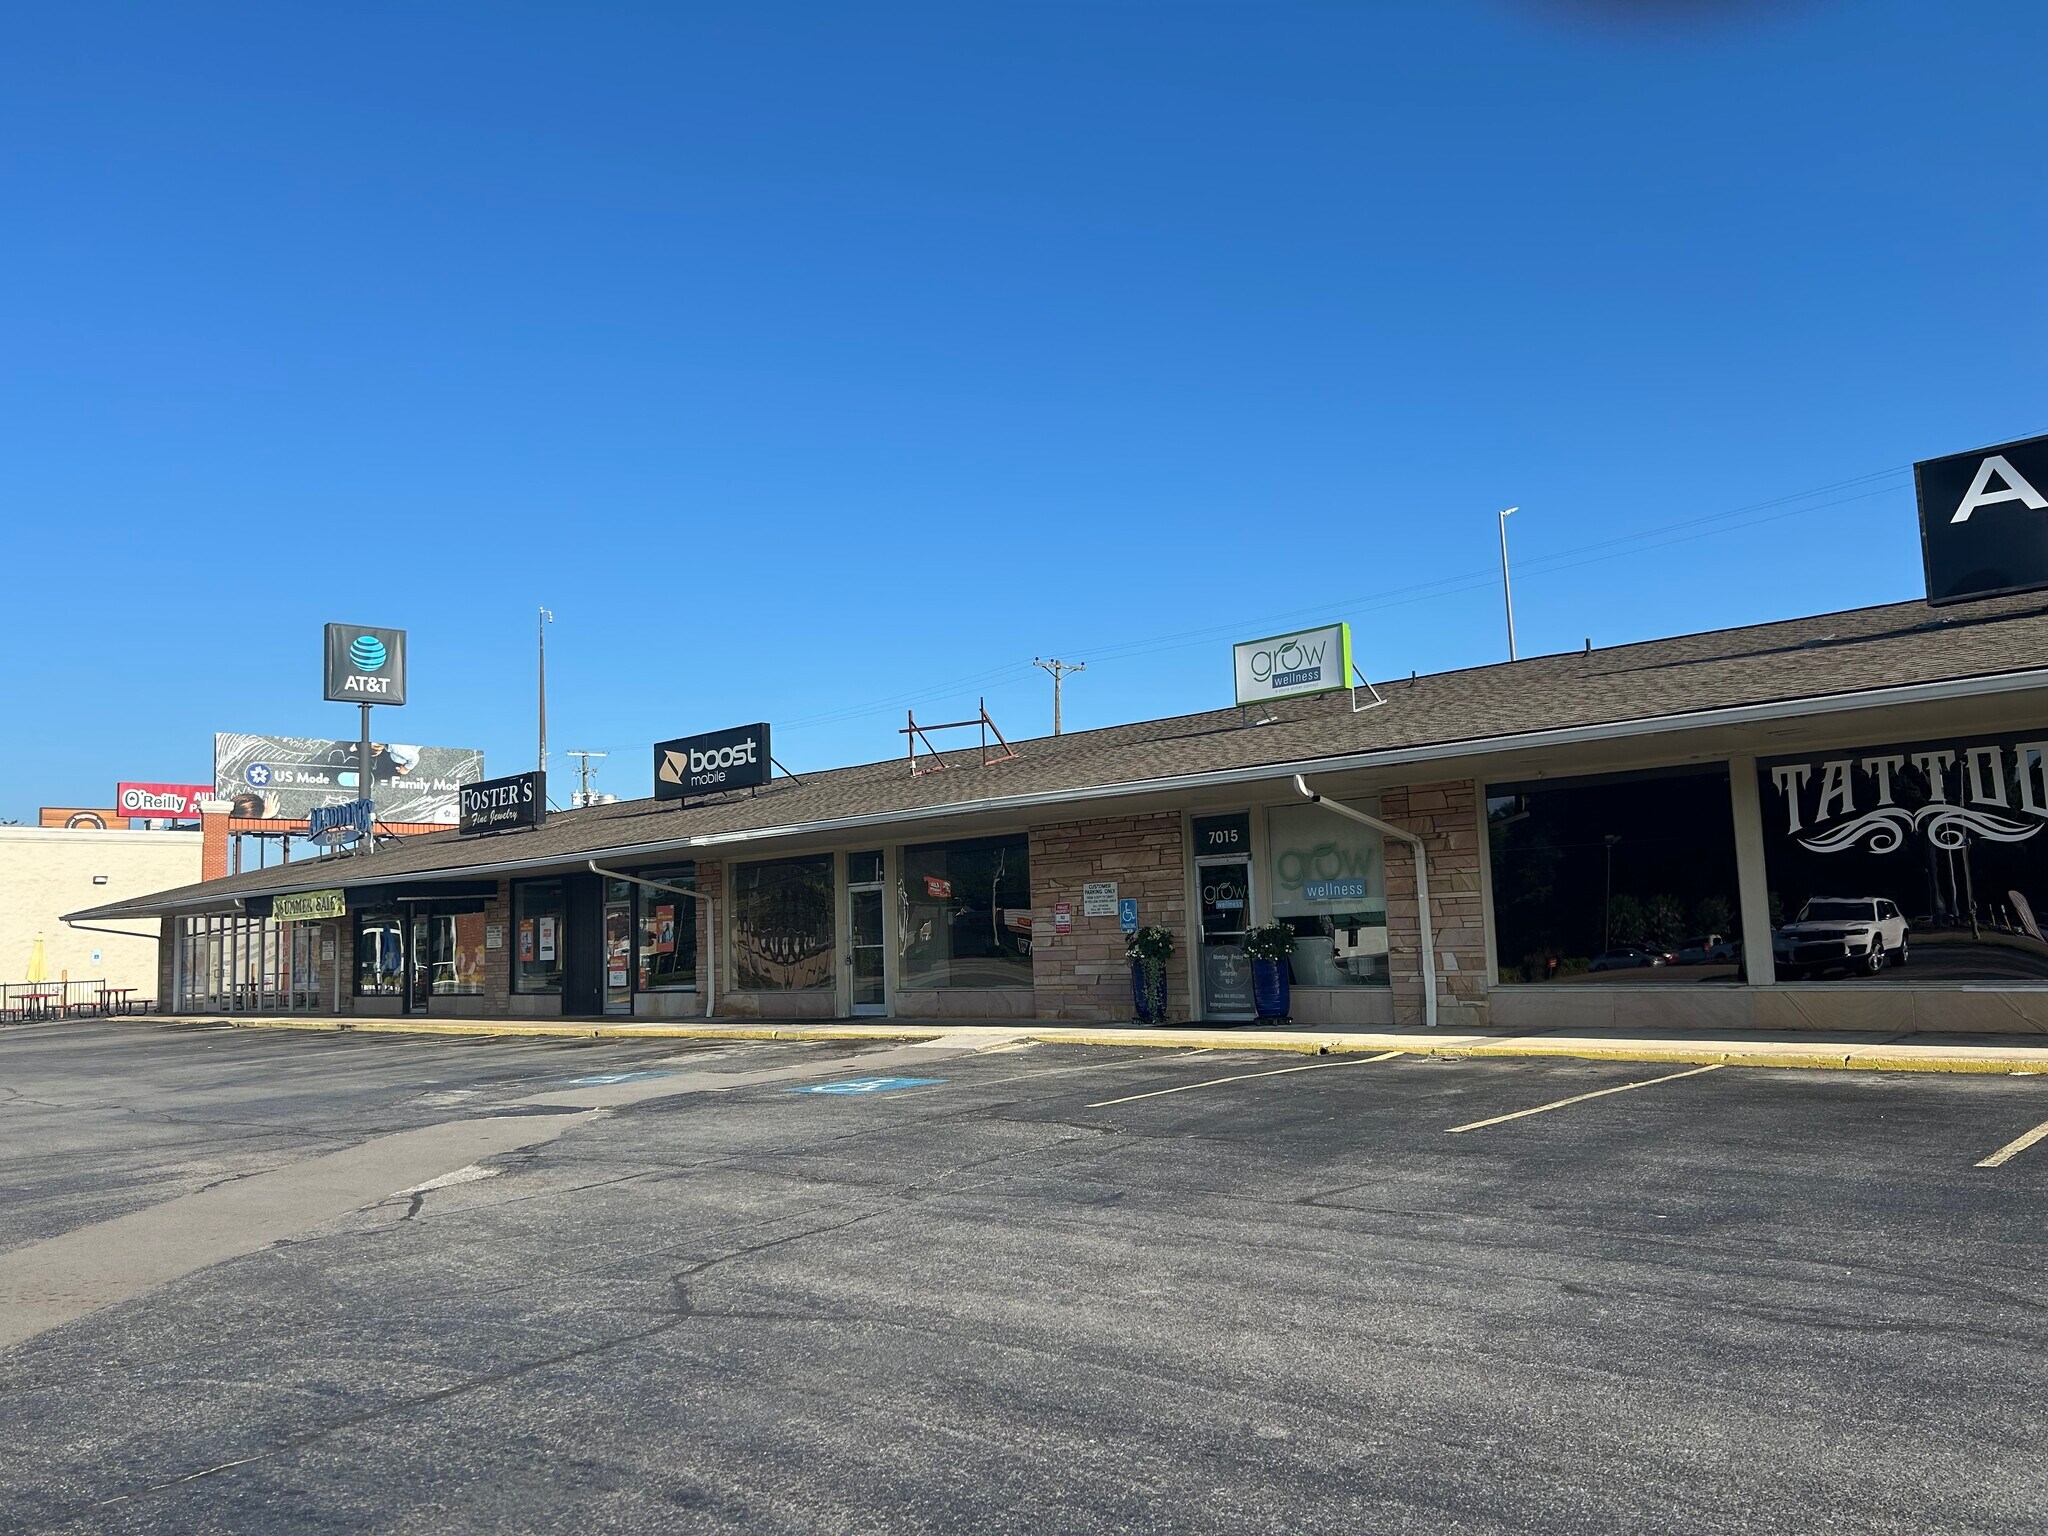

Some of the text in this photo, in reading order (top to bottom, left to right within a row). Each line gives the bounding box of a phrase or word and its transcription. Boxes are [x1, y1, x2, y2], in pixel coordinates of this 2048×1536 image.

[1251, 640, 1326, 682] grow
[344, 675, 391, 693] AT&T
[1274, 671, 1319, 686] wellness
[690, 738, 757, 773] boost
[274, 772, 293, 783] US
[297, 772, 330, 784] Mode
[391, 776, 431, 794] Family
[432, 778, 460, 791] Mod
[691, 771, 726, 787] mobile
[124, 790, 185, 812] O'Reilly
[193, 791, 215, 801] AUT
[460, 779, 533, 818] FOSTER'S
[471, 808, 518, 827] Fine Jewelry
[325, 832, 346, 845] CAFE
[1208, 829, 1239, 845] 7015
[1278, 843, 1373, 890] grow
[1203, 882, 1247, 905] grow
[1306, 883, 1363, 897] wellness
[280, 895, 337, 915] SUMMER SALE
[1216, 900, 1243, 909] wellness
